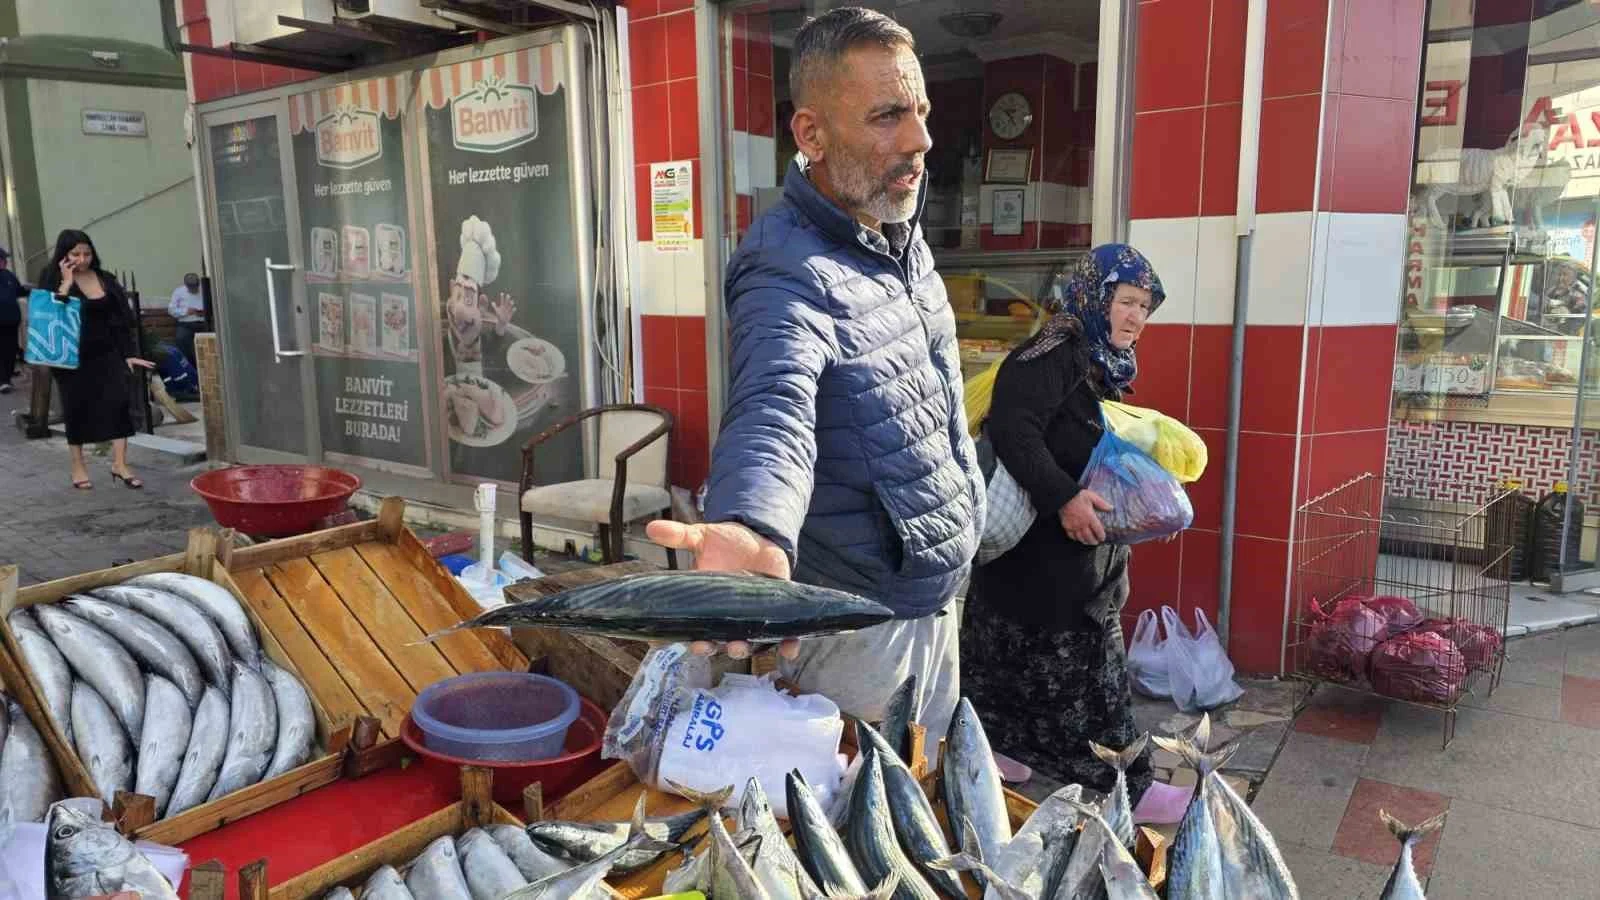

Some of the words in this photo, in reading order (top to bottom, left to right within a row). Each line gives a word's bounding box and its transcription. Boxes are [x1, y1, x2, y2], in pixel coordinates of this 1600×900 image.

[458, 98, 529, 136] Banvit
[320, 121, 375, 154] Banvit
[448, 168, 467, 184] Her
[468, 166, 512, 183] lezzette
[513, 162, 549, 182] güven
[314, 183, 329, 197] Her
[363, 178, 392, 195] güven
[344, 375, 393, 397] BANVİT
[335, 397, 409, 422] LEZZETLERİ
[344, 419, 401, 443] BURADA!
[695, 700, 725, 752] GPS
